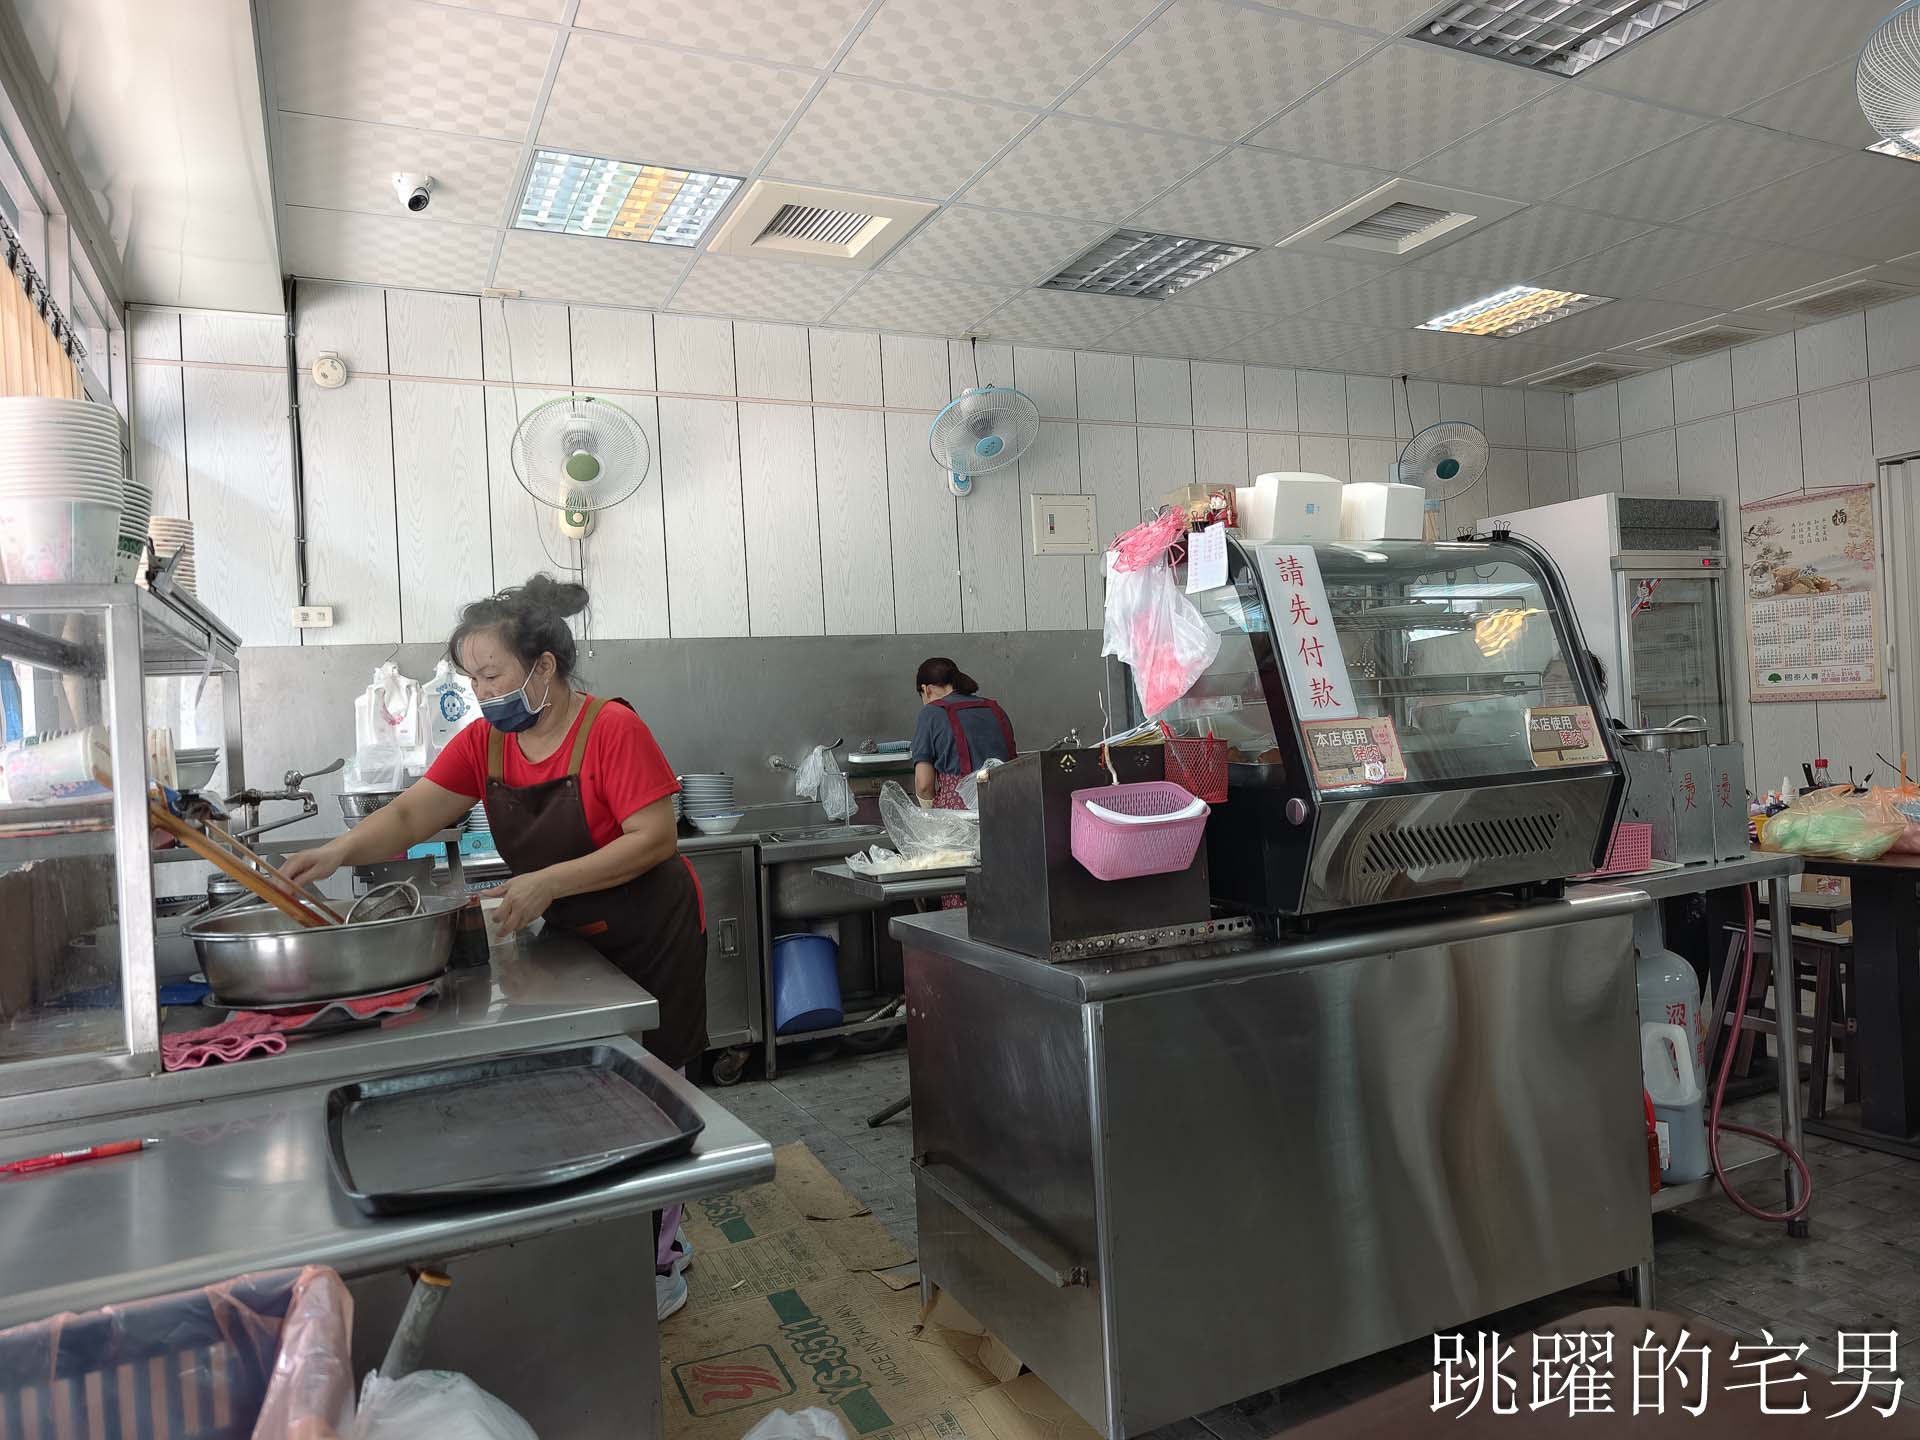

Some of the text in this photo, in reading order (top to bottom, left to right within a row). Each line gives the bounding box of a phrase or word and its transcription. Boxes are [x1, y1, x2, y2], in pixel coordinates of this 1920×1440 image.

[1275, 555, 1341, 709] 請先付款
[1314, 728, 1368, 747] 本店使用
[1530, 716, 1573, 732] 本店使用
[833, 1303, 872, 1342] TAIWAN
[871, 1353, 910, 1386] MADE
